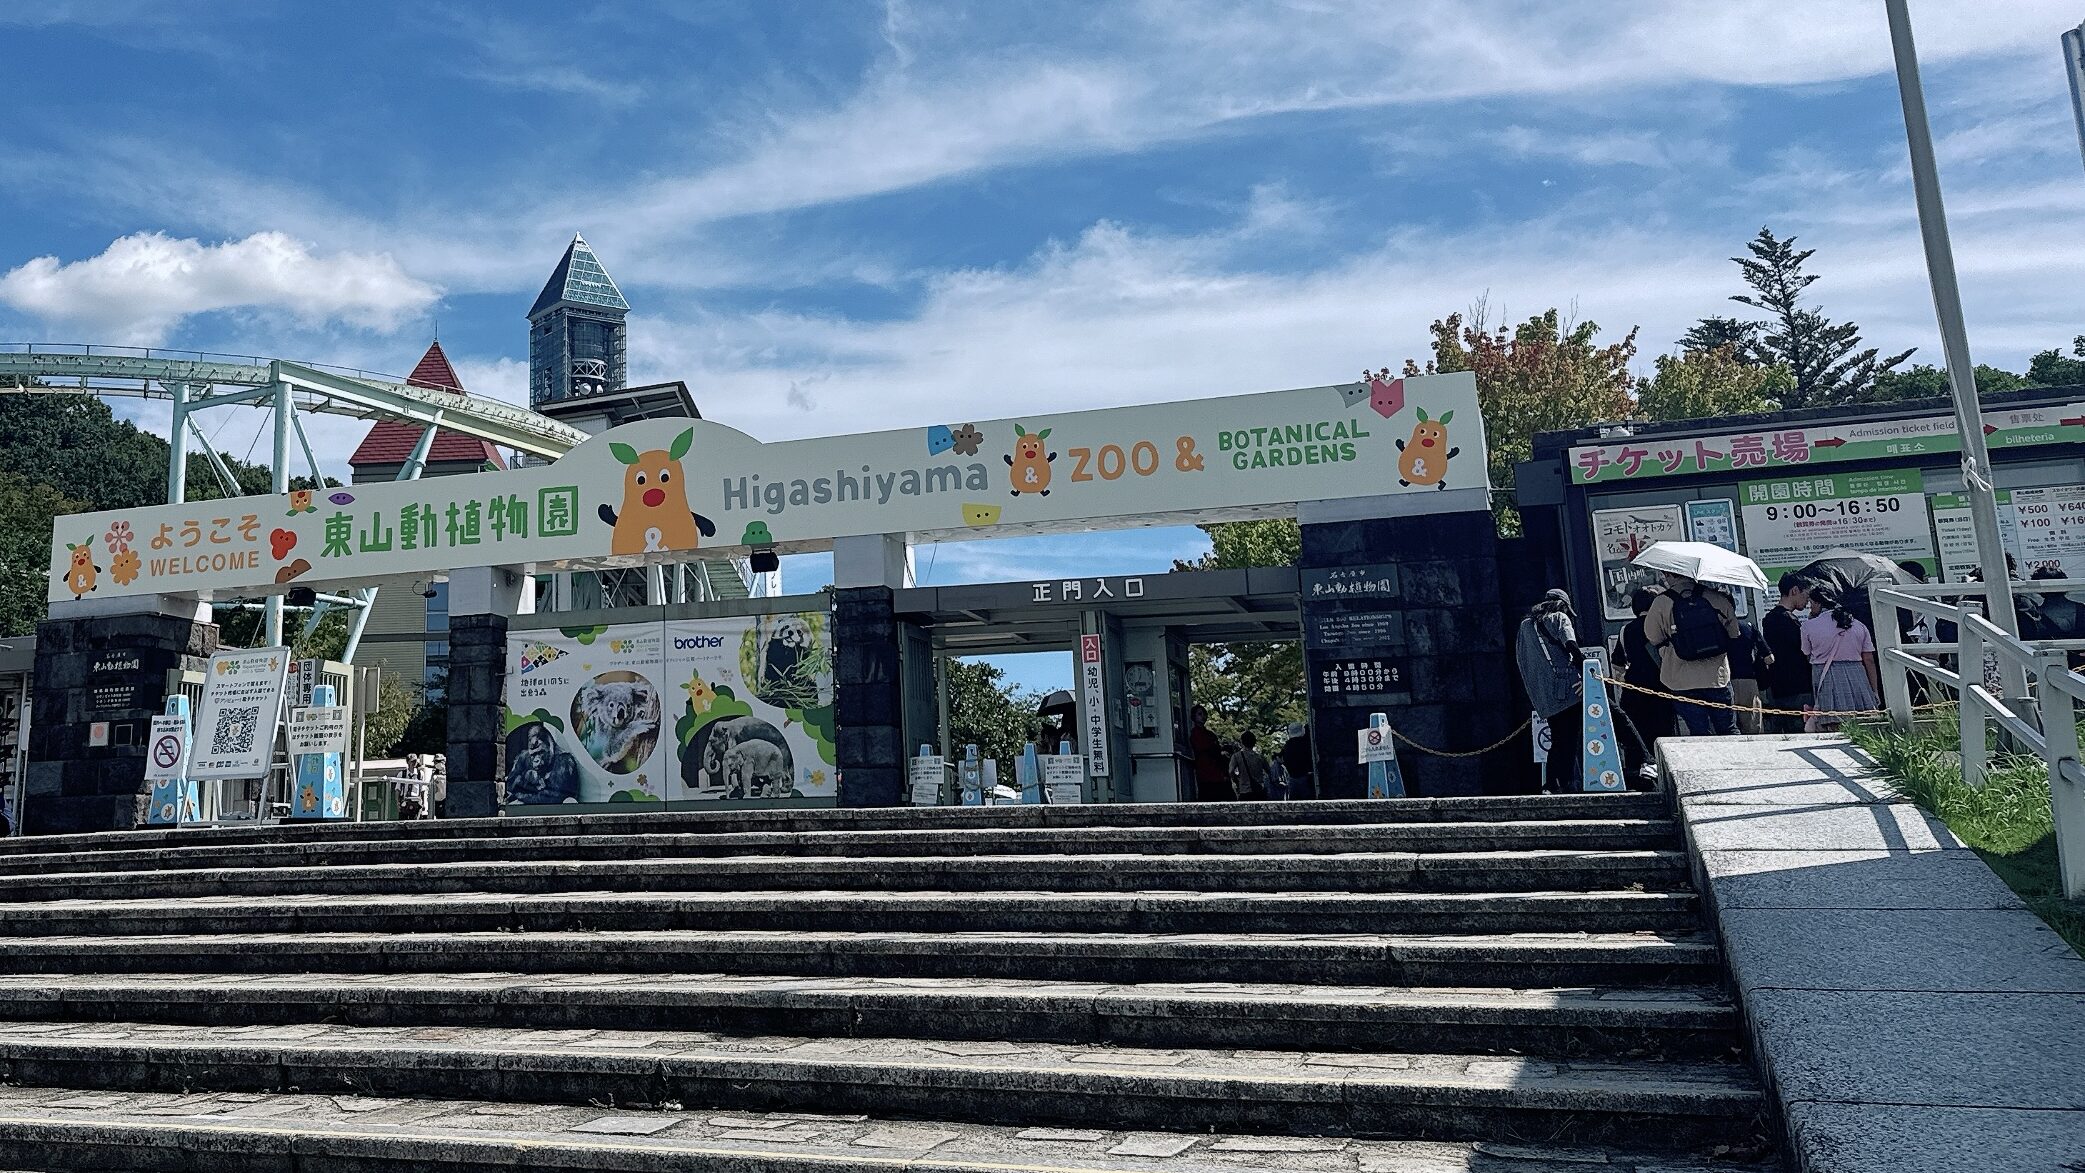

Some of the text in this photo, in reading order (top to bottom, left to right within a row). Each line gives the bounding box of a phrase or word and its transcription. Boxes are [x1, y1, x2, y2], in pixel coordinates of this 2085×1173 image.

[1850, 420, 1955, 438] Admission ticket field
[2009, 413, 2045, 424] 售票处
[1218, 419, 1370, 452] BOTANICAL
[2005, 433, 2055, 444] bilheteria
[1068, 435, 1205, 483] ZOO &
[1232, 442, 1357, 471] GARDENS
[1578, 431, 1810, 480] チケット売場
[1886, 442, 1926, 454] 매표소
[723, 462, 989, 515] Higashiyama
[1748, 478, 1836, 502] 開園時間
[2018, 504, 2048, 514] ¥500
[2060, 515, 2085, 525] ¥16
[150, 514, 262, 550] ようこそ
[320, 485, 579, 558] 東山動植物園
[1603, 521, 1674, 536] コモドオオトカゲ
[2020, 518, 2051, 528] ¥100
[150, 550, 260, 576] WELCOME
[2024, 559, 2061, 570] ¥2000
[1032, 577, 1145, 602] 正門入口
[1312, 578, 1390, 596] 東山動植物園
[674, 635, 724, 650] brother
[1085, 638, 1097, 661] 入口
[303, 660, 312, 705] 団体専用
[1087, 666, 1105, 773] 幼児、小・中学生無料
